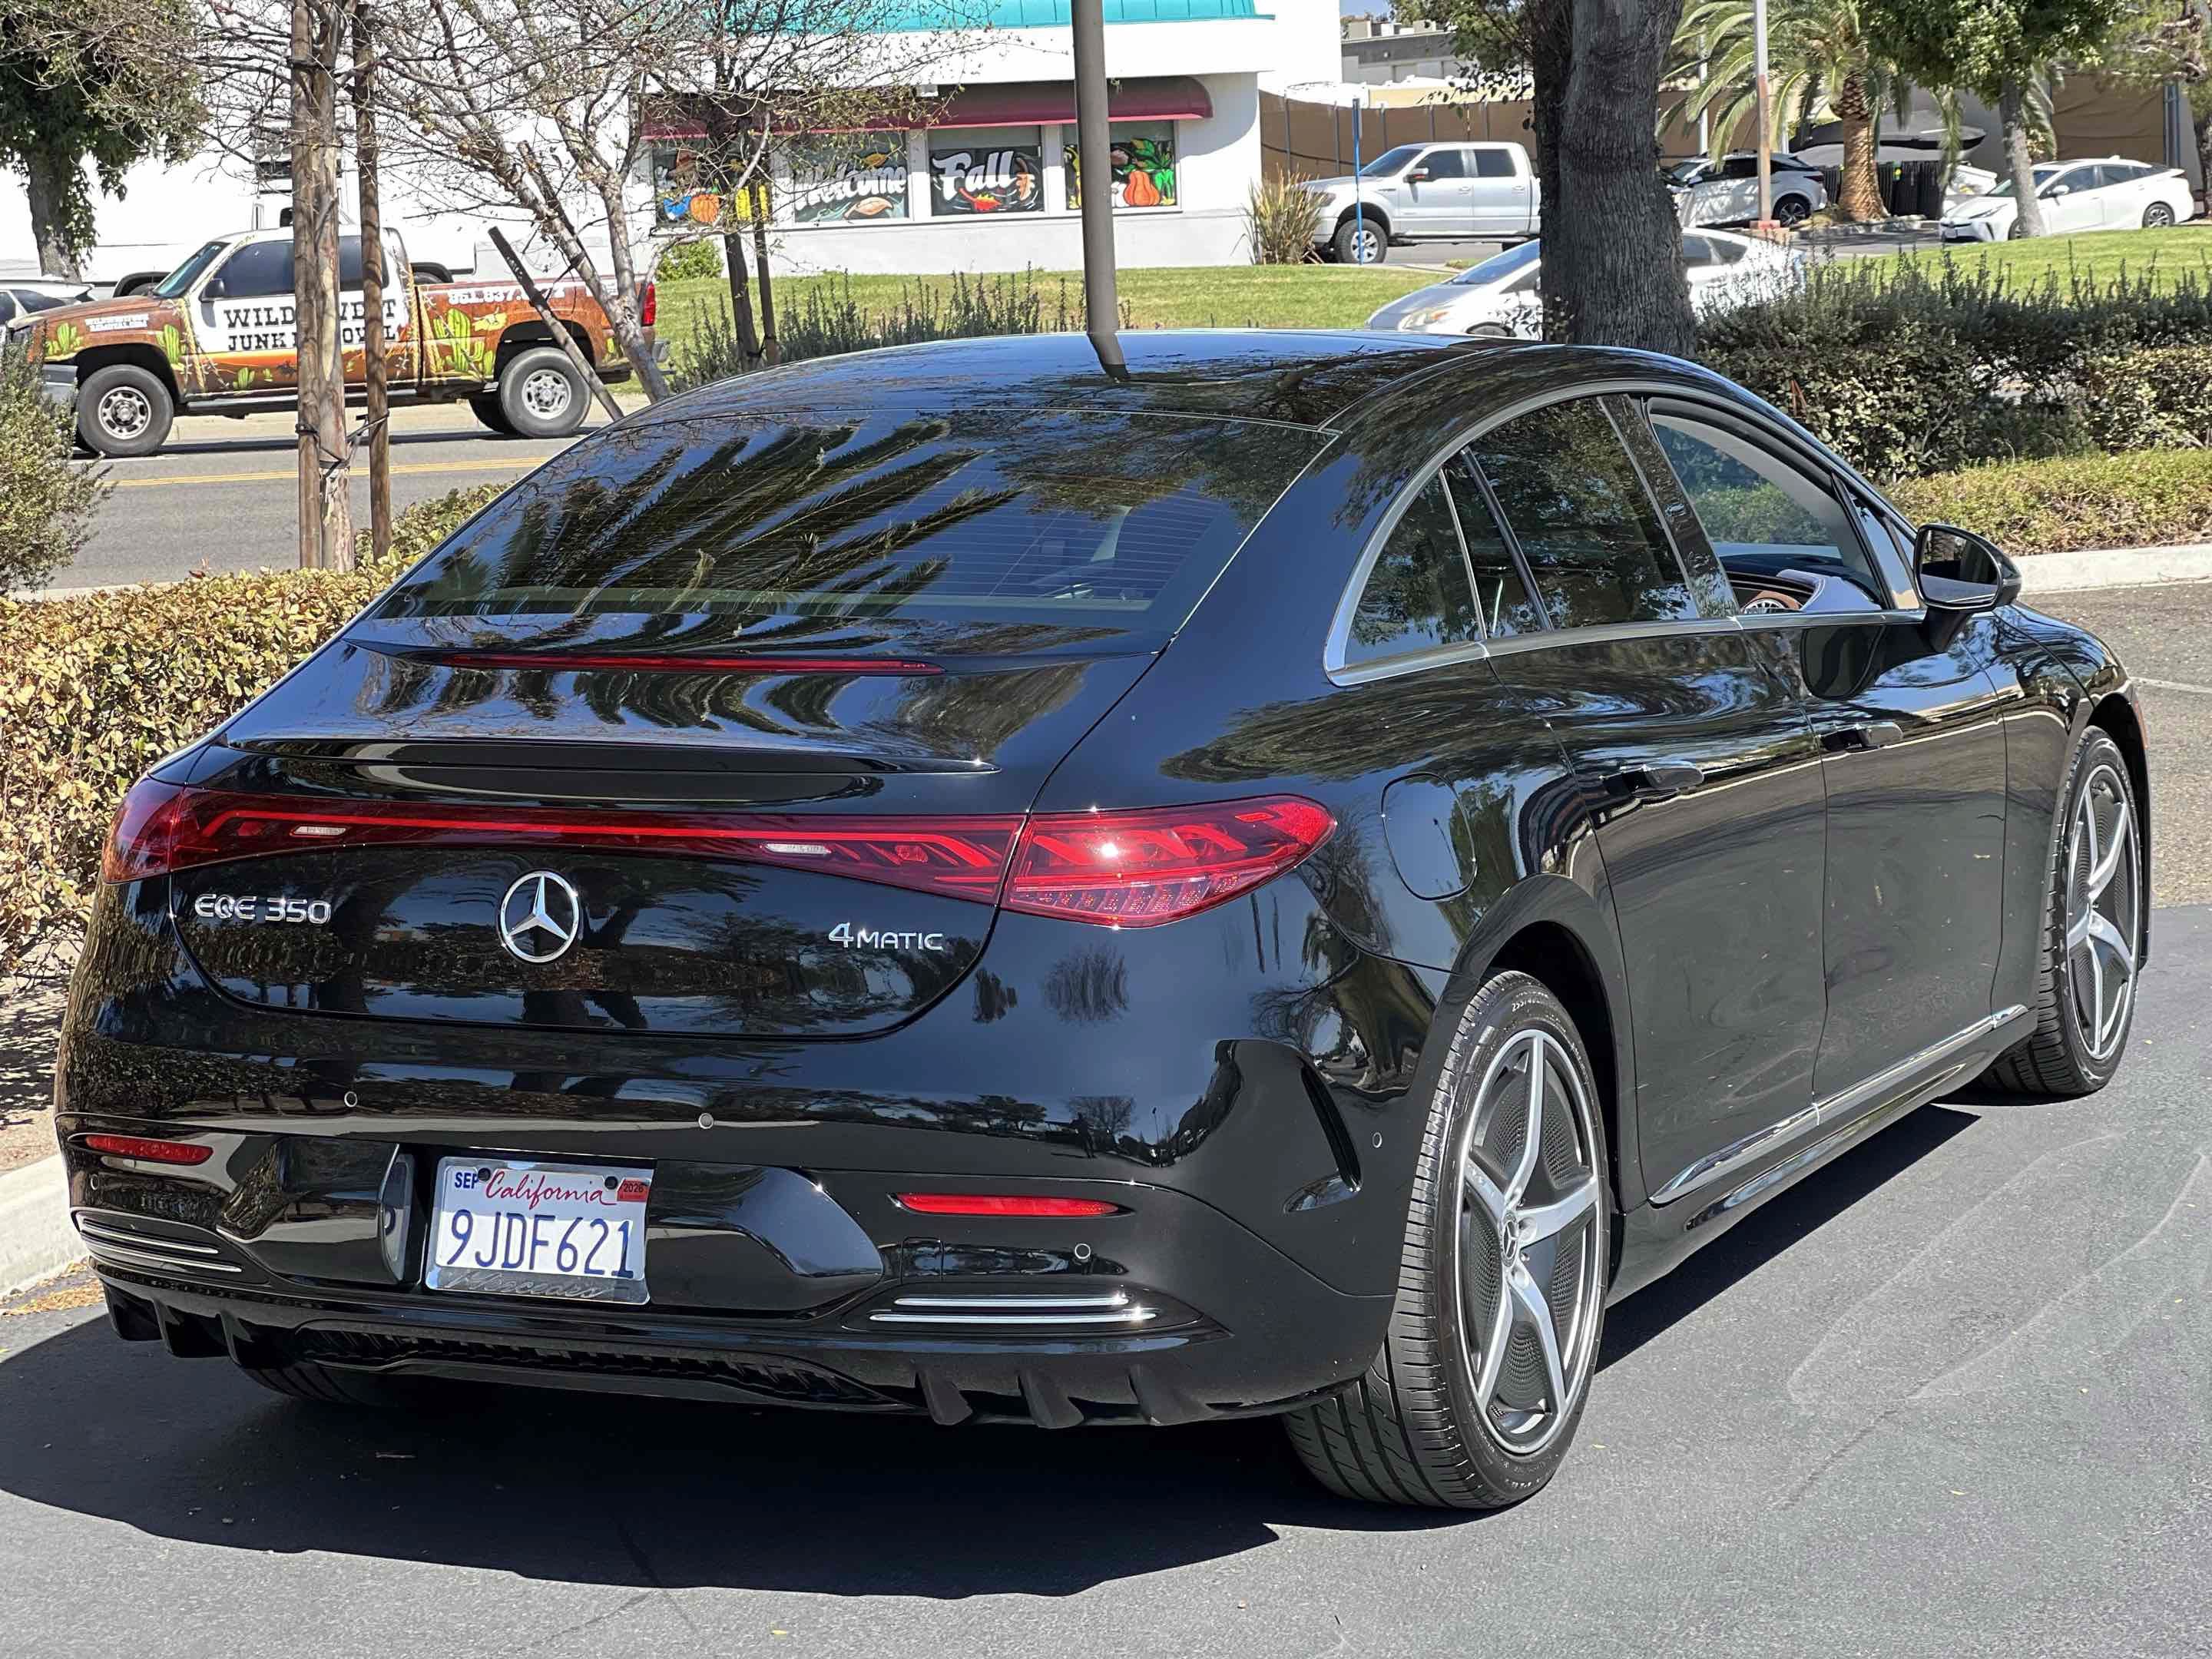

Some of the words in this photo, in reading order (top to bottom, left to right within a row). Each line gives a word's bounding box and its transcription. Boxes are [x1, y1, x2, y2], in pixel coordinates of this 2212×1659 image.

[932, 151, 1018, 200] Fall
[224, 306, 296, 328] WILD
[228, 332, 286, 350] JUNK
[194, 893, 257, 920] EQE
[264, 896, 332, 924] 350
[828, 922, 944, 951] 4MATIC
[454, 1171, 479, 1190] SEP
[485, 1171, 617, 1210] California
[623, 1183, 644, 1193] 2026
[446, 1209, 634, 1279] 9JDF621
